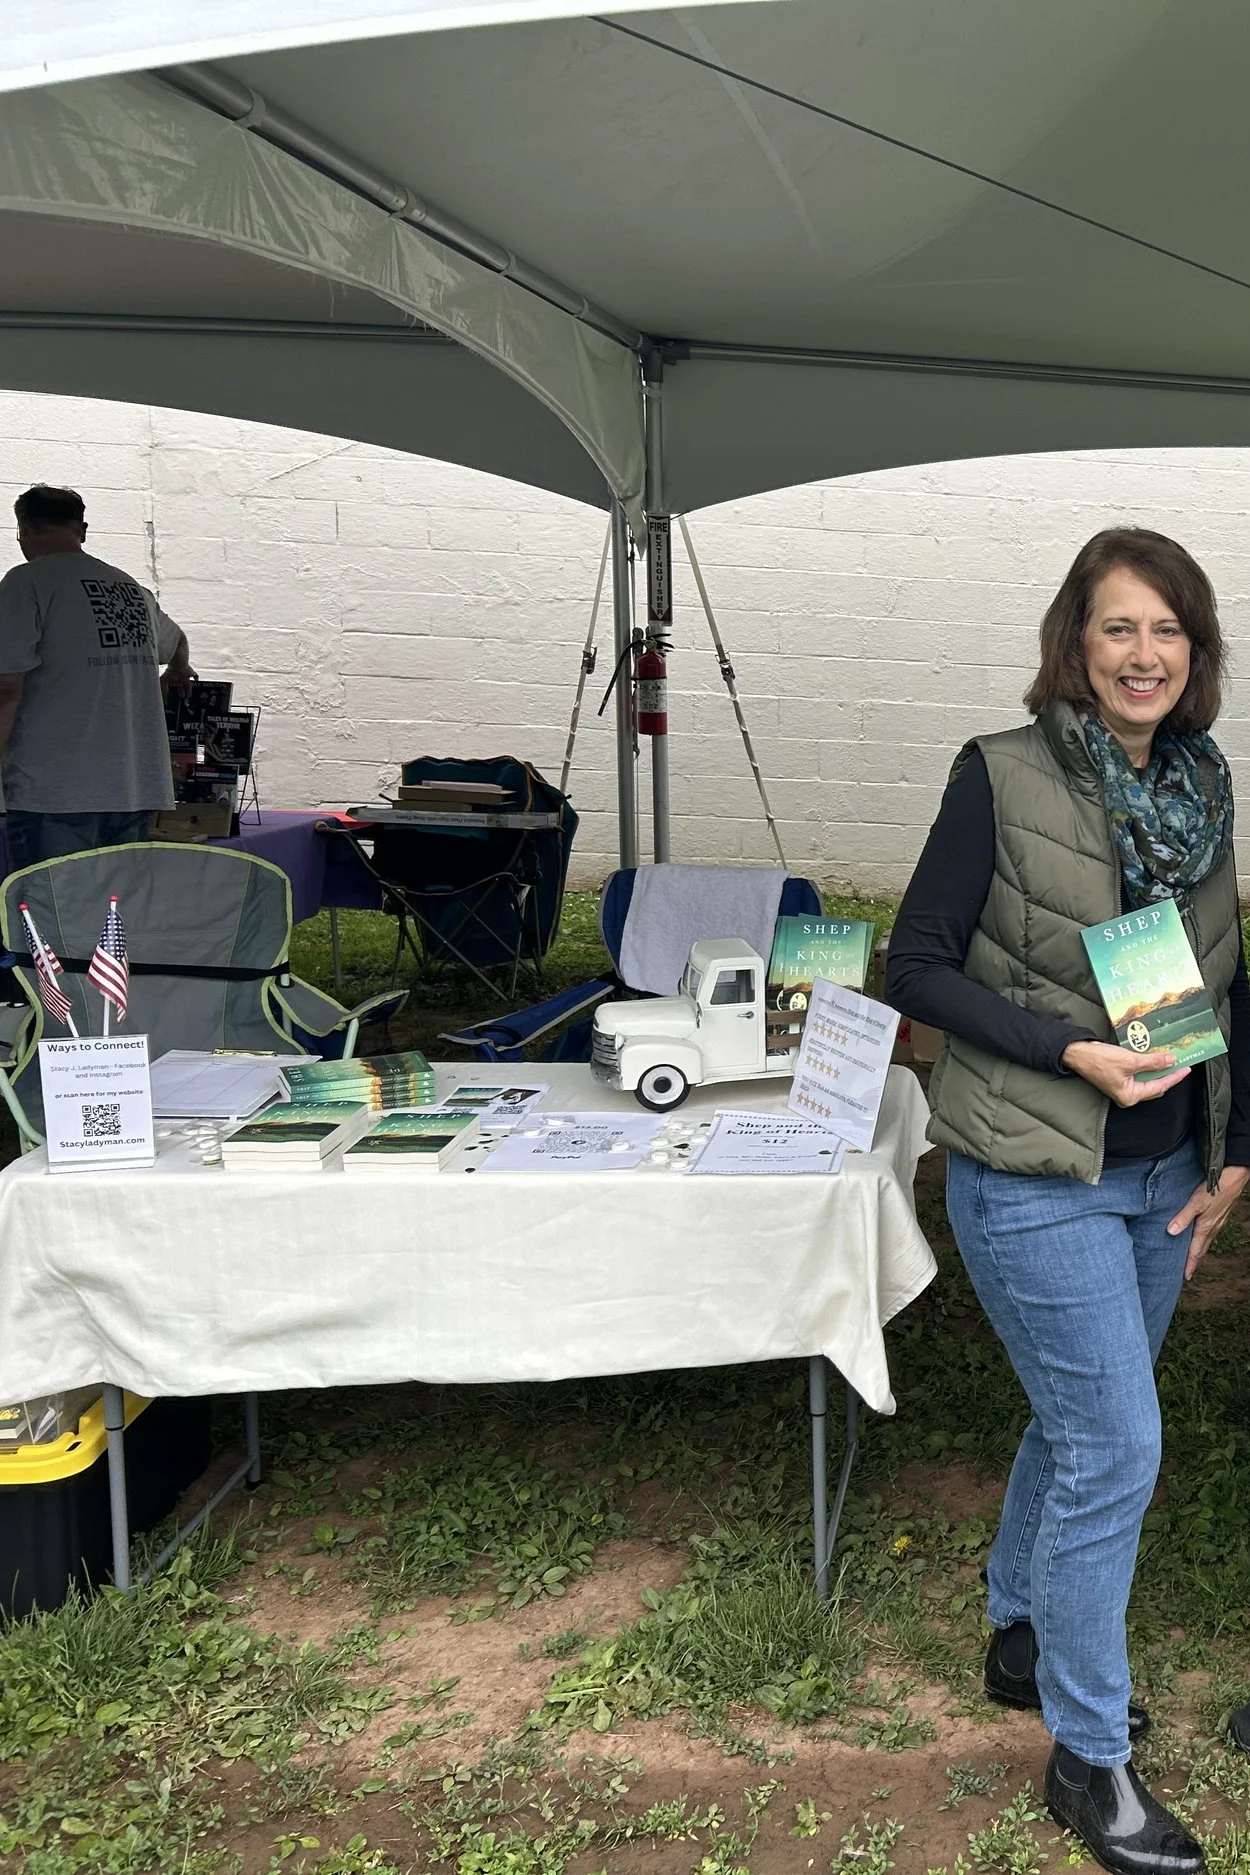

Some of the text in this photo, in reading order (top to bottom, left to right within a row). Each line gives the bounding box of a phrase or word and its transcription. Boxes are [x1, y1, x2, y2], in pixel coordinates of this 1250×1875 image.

[649, 522, 668, 532] FIRE
[656, 534, 664, 615] EXTINGUISHER
[803, 924, 851, 934] SHEP
[1104, 910, 1161, 942] SHEP
[1120, 935, 1158, 952] AND THE
[797, 950, 842, 960] KING
[1109, 949, 1166, 980] KING
[789, 966, 860, 976] HEARTS
[47, 1044, 77, 1053] Ways
[94, 1041, 144, 1050] Connect!
[60, 1138, 145, 1148] Stacyladyman.com
